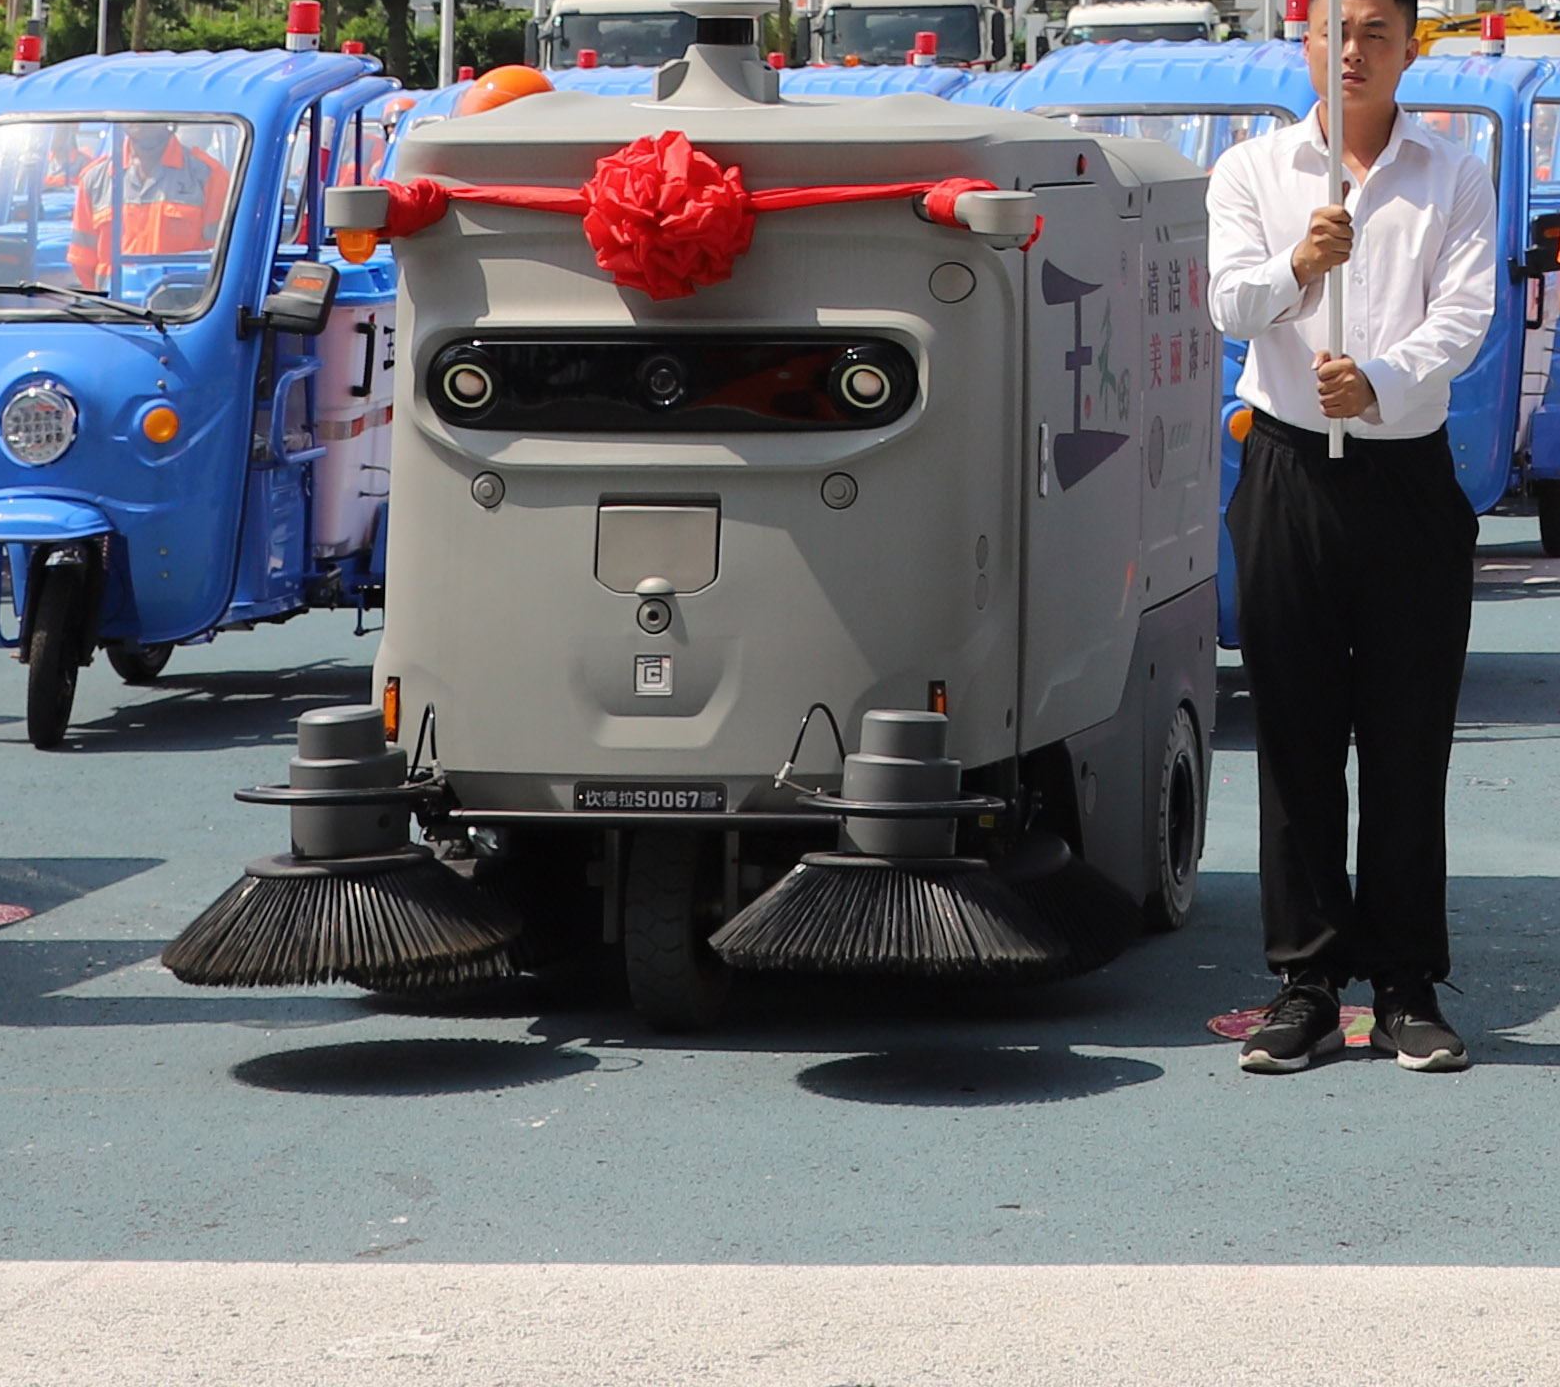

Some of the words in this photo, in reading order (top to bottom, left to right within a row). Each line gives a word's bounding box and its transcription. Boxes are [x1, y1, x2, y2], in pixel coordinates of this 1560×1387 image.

[1147, 257, 1209, 317] 清洁城
[585, 790, 700, 808] 坎德拉S0067
